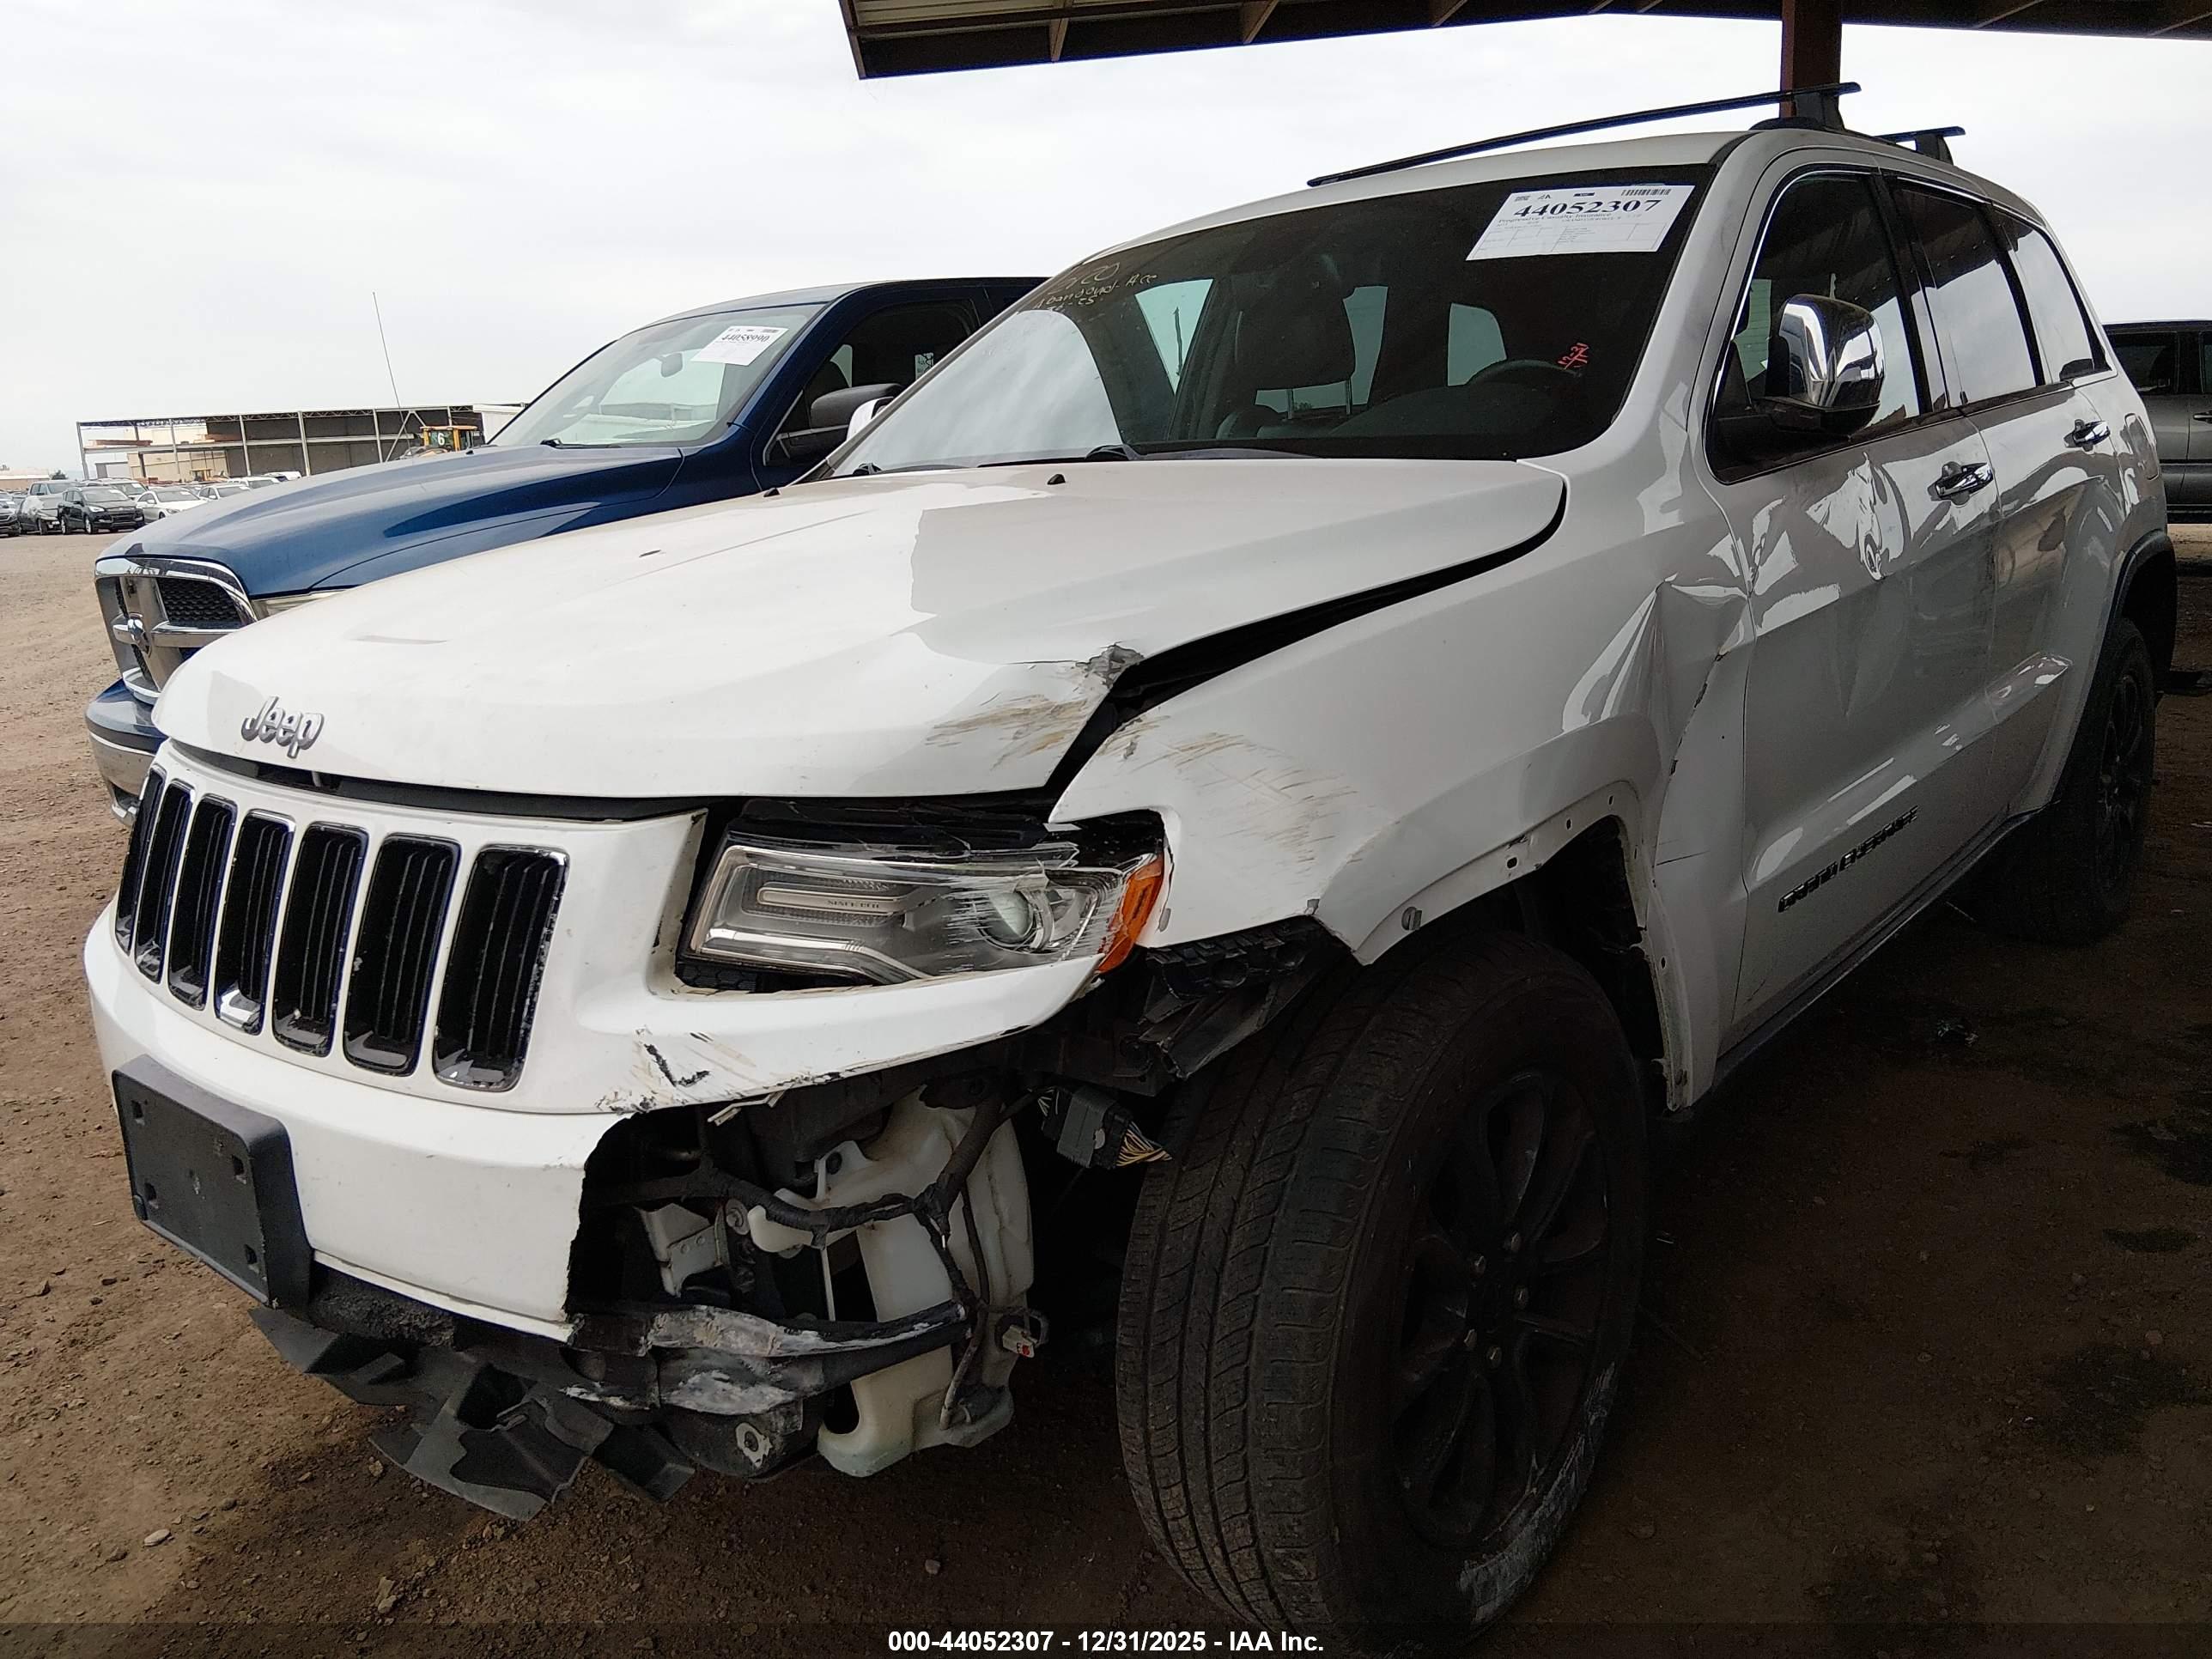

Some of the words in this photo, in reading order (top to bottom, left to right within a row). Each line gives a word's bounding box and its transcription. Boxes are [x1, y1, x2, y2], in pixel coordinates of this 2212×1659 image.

[1514, 199, 1662, 216] 44052307
[437, 432, 446, 446] 6
[241, 696, 325, 759] Jeep
